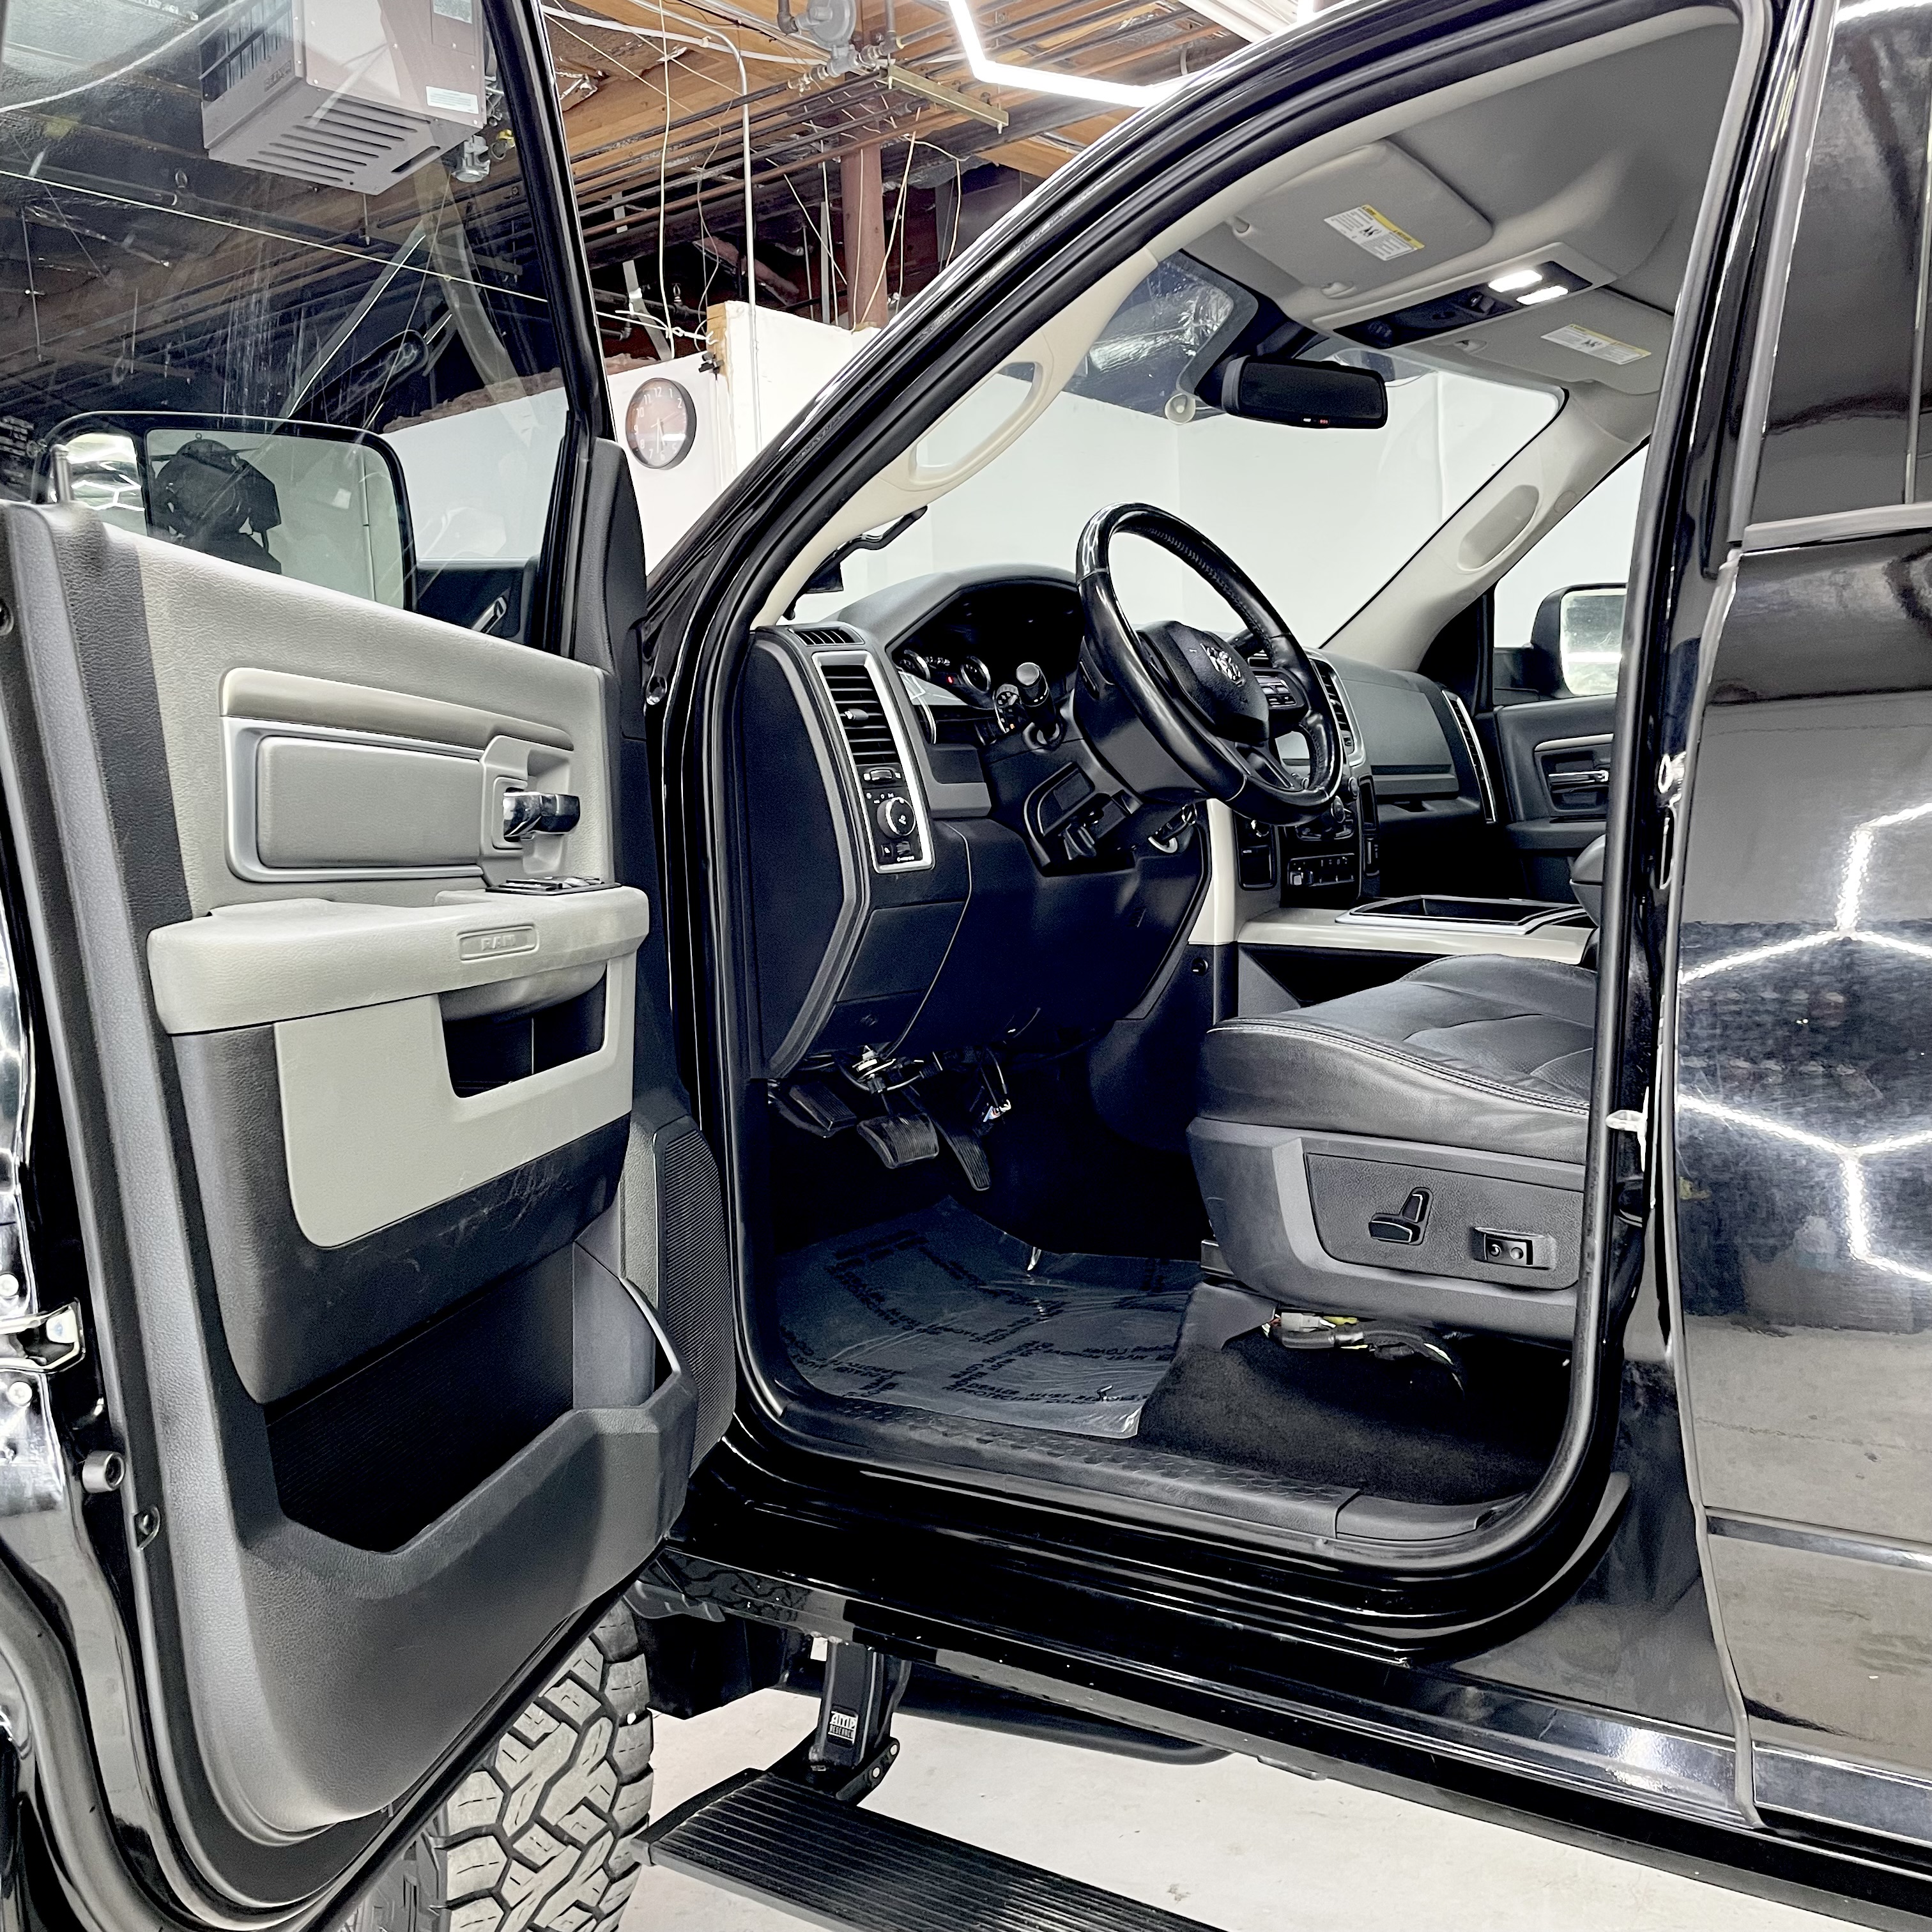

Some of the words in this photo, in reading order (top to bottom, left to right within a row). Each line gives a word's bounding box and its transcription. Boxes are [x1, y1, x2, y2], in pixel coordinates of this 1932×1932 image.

[654, 387, 663, 397] 12
[669, 388, 673, 398] 1
[643, 394, 651, 405] 11
[677, 397, 682, 408] 2
[636, 407, 645, 418] 10
[633, 424, 638, 435] 9
[640, 439, 645, 449] 8
[649, 448, 654, 459] 7
[480, 934, 517, 951] RAM
[830, 1712, 858, 1731] AMP
